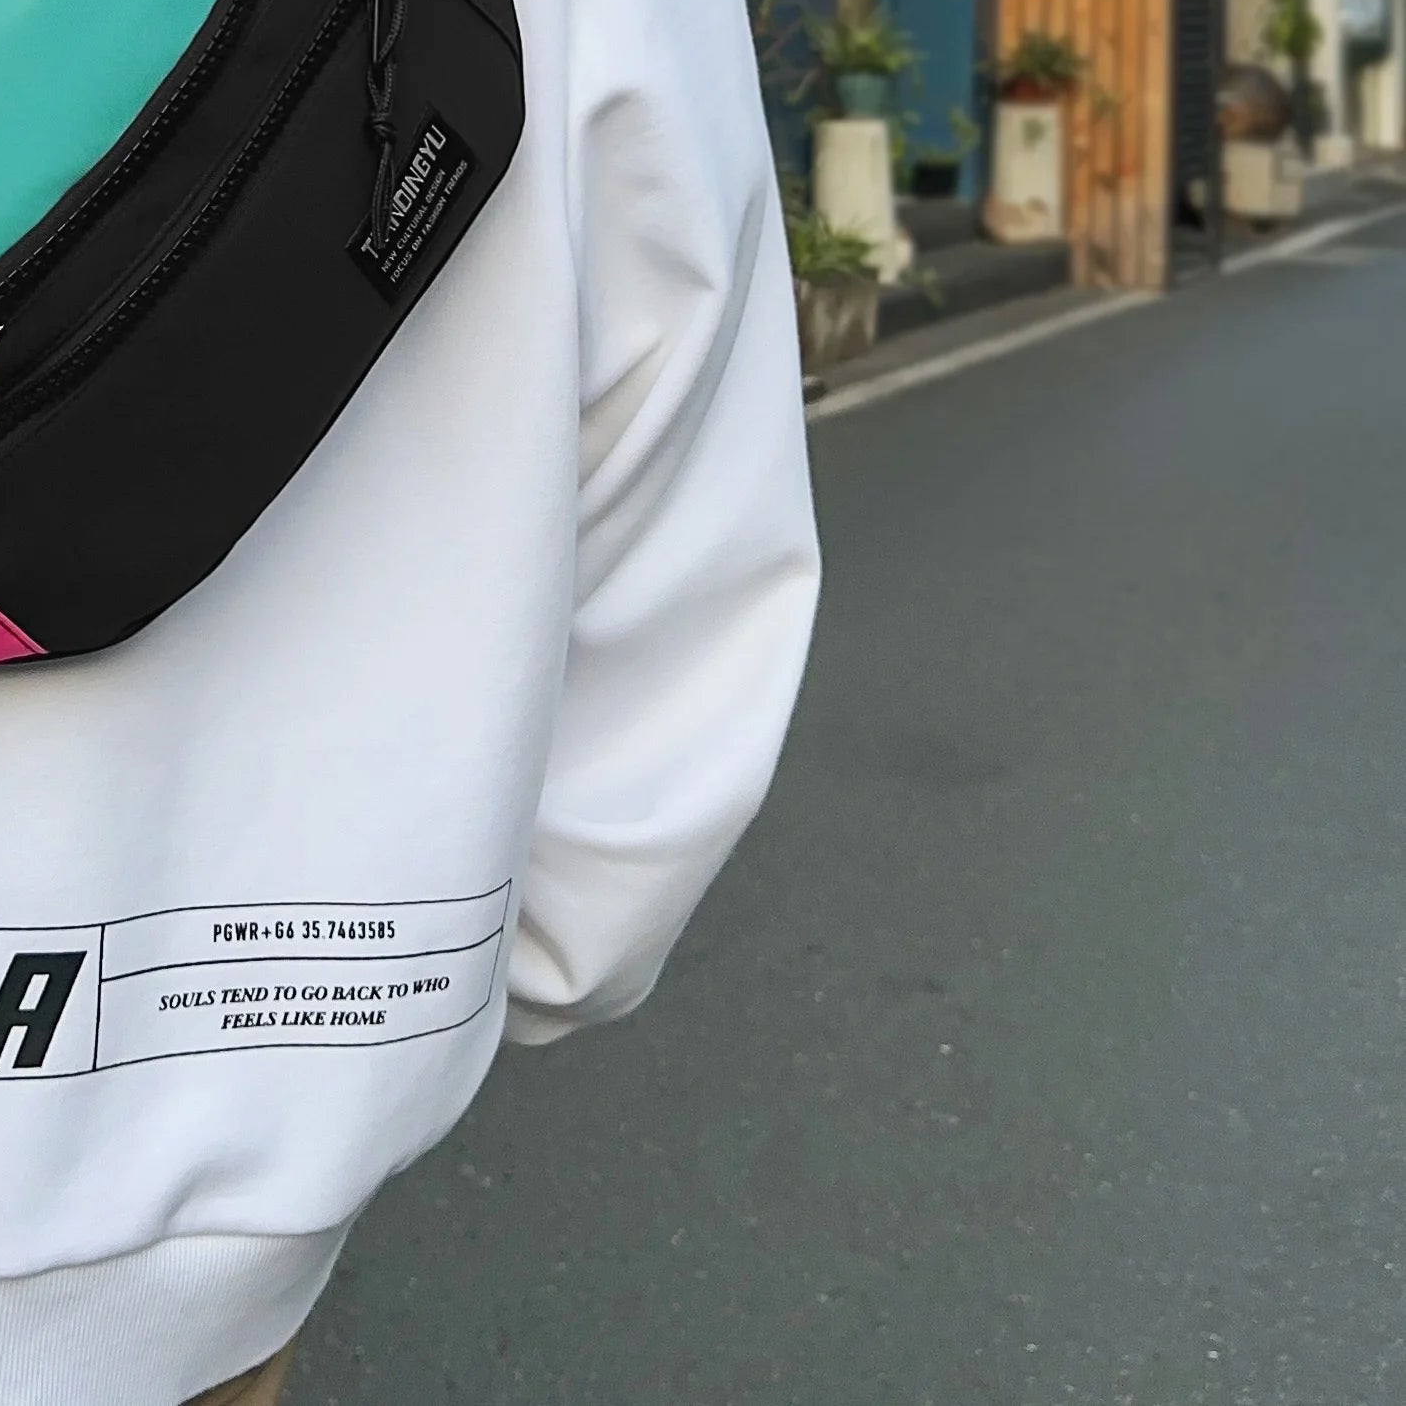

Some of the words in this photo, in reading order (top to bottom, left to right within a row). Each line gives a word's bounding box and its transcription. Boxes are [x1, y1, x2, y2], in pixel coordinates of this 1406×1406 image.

[361, 125, 446, 258] TNDINGYU
[381, 250, 397, 272] NEW
[396, 204, 428, 249] CULTURAL
[425, 169, 445, 204] DESIGN
[390, 251, 412, 282] FOCUS
[411, 235, 423, 251] ON
[422, 197, 446, 235] FASHION
[214, 921, 294, 942] PGWR+G6
[303, 921, 394, 940] 35.7463585
[159, 991, 216, 1010] SOULS
[222, 988, 268, 1003] TEND
[274, 987, 296, 1000] TO
[302, 987, 327, 1000] GO
[332, 986, 383, 1000] BACK
[388, 984, 408, 998] TO
[413, 977, 449, 994] WHO
[221, 1012, 277, 1029] FEELS
[281, 1012, 326, 1025] LIKE
[330, 1011, 386, 1025] HOME
